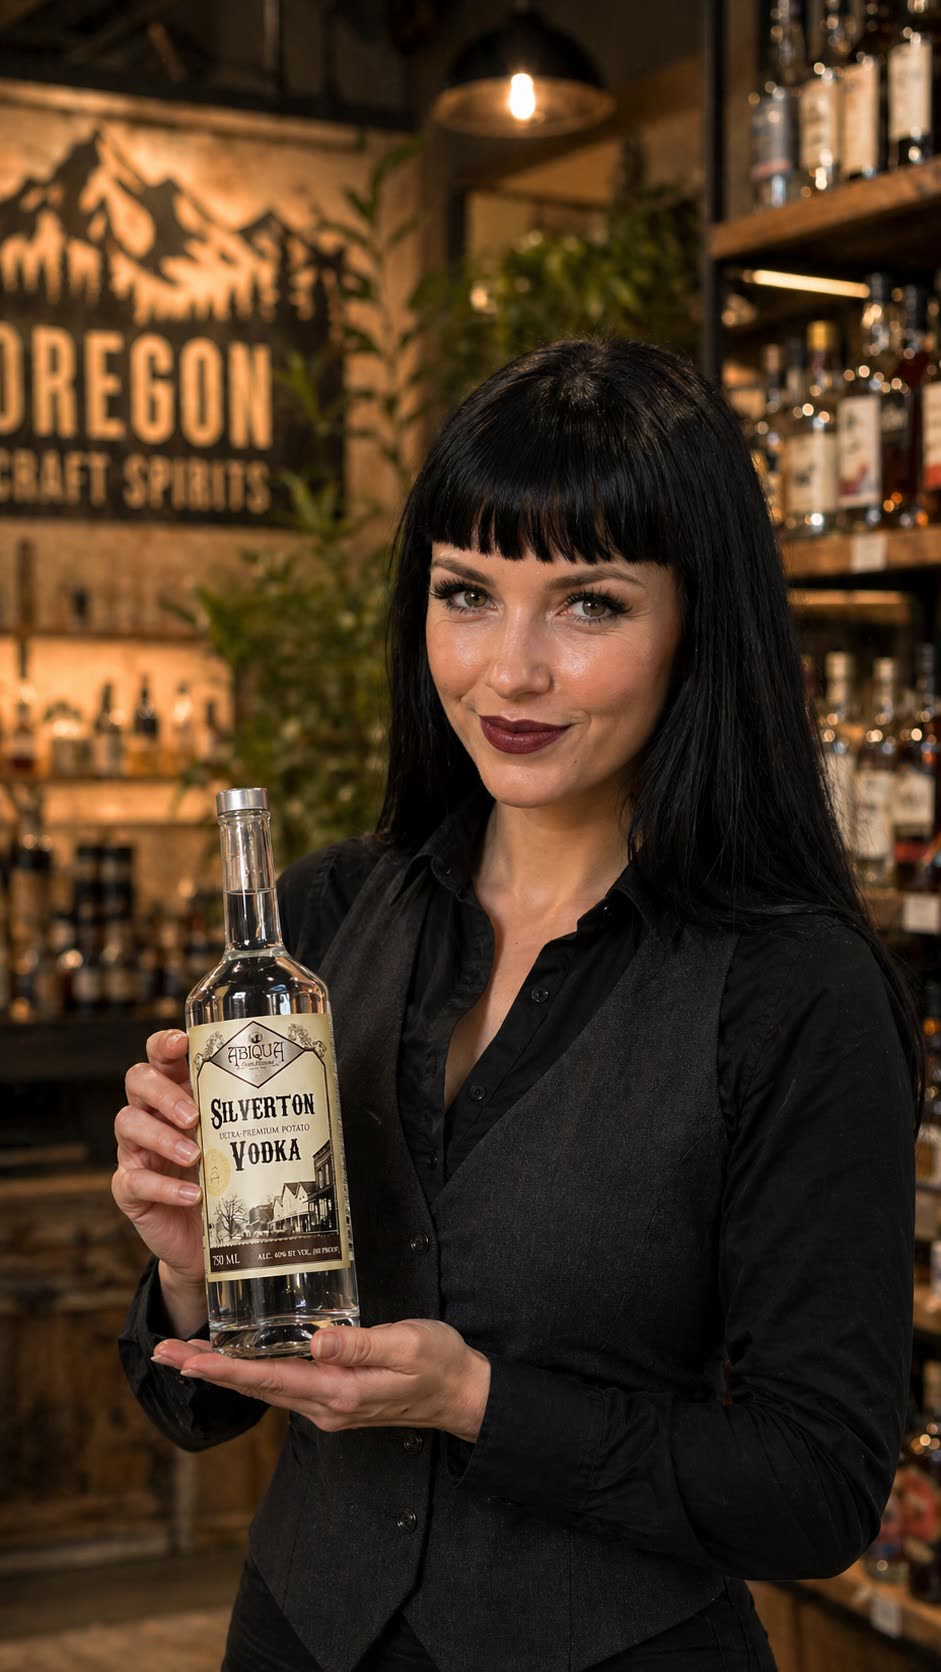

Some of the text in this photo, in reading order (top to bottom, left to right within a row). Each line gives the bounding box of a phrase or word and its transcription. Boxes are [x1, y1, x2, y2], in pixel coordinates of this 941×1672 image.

[0, 321, 272, 448] OREGON
[123, 454, 270, 514] SPIRITS
[228, 1041, 285, 1069] ABIQUA
[281, 1123, 310, 1133] POTATO
[212, 1253, 240, 1266] 750 ML
